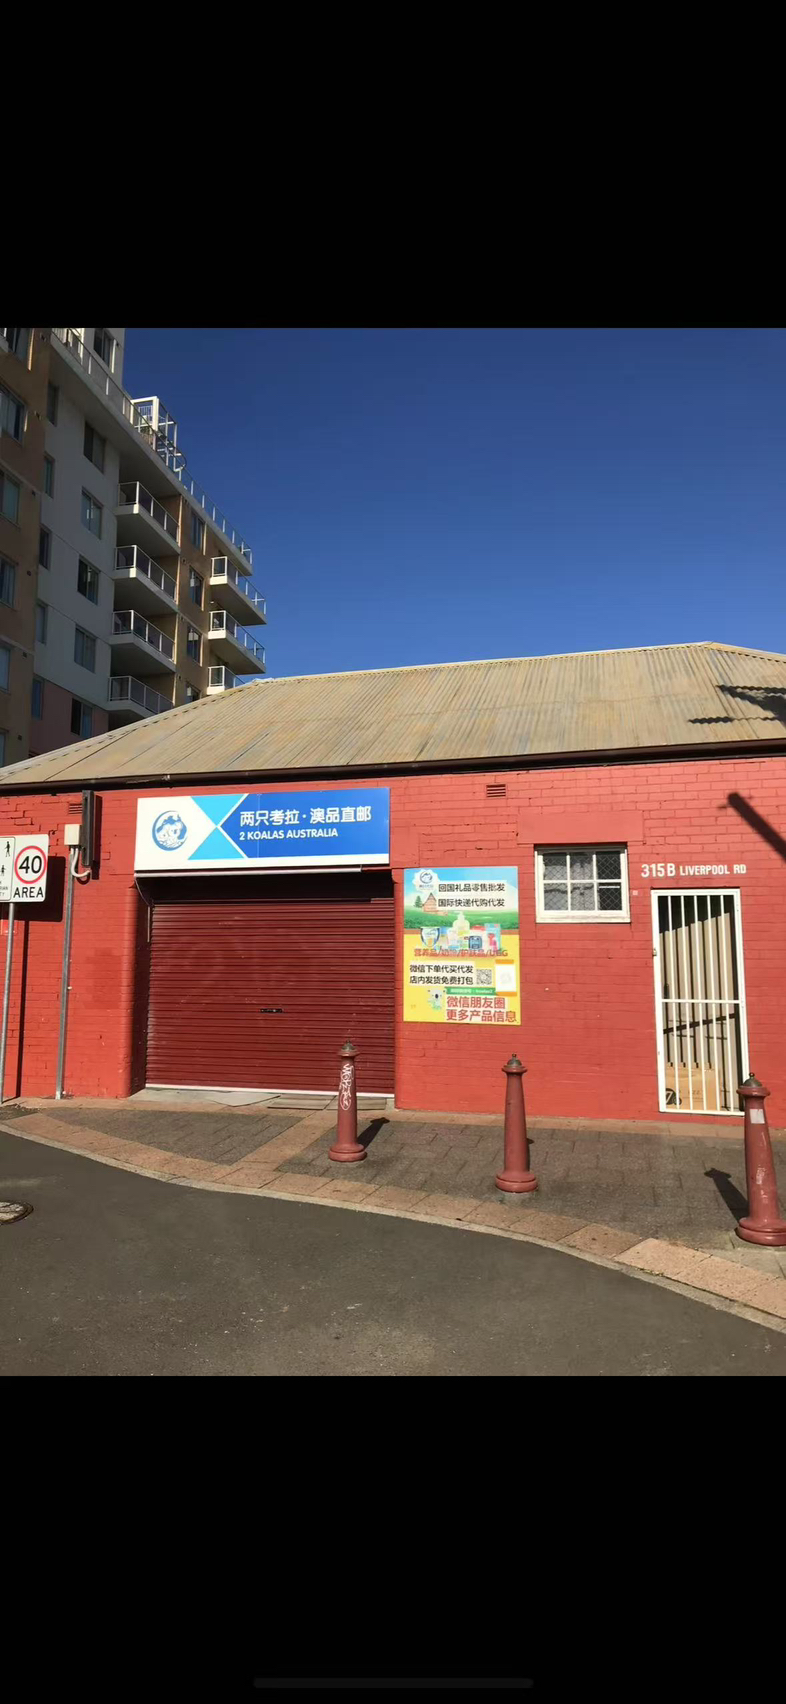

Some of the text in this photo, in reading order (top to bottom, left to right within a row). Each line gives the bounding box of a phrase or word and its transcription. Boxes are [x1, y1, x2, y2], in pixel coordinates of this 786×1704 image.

[240, 805, 371, 827] 两只考拉·澳品直邮
[239, 828, 338, 840] 2 KOALAS AUSTRALIA
[19, 855, 42, 874] 40
[679, 865, 730, 876] LIVERPOOL
[733, 864, 747, 874] RD
[13, 886, 44, 898] AREA
[438, 883, 505, 892] 回国礼品零售批发
[437, 898, 505, 907] 国际快递代购代发
[409, 964, 473, 973] 微信下单代买代发
[409, 975, 473, 985] 店内发货免费打包
[446, 996, 505, 1009] 微信朋友圈
[446, 1009, 517, 1022] 更多产品信息
